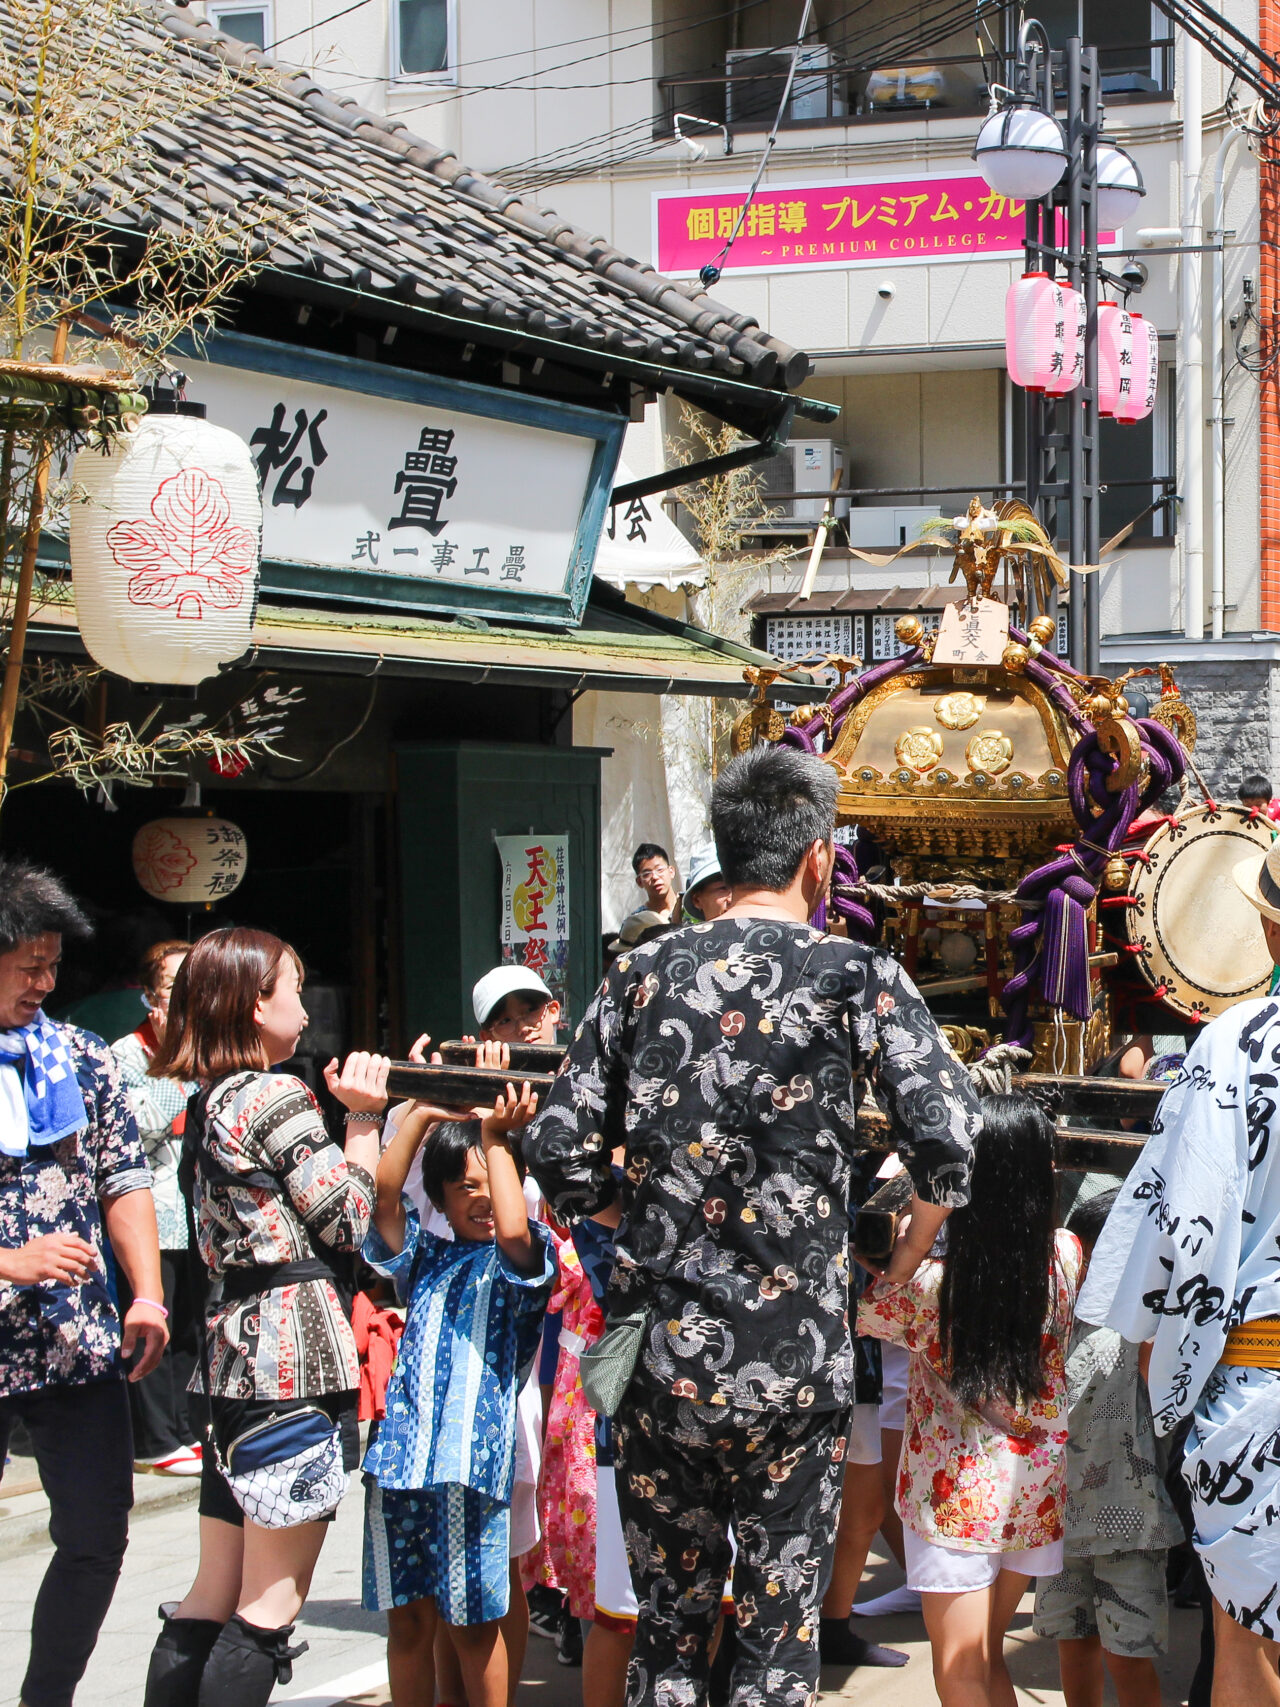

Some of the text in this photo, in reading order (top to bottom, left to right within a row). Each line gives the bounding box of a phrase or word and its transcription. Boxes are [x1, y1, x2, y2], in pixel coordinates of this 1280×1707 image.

[686, 188, 1045, 240] 個別指導 プレミアム・カレ
[781, 233, 987, 258] PREMIUM COLLEGE
[250, 402, 328, 509] 松
[606, 497, 653, 544] 会
[522, 845, 549, 980] 天王祭
